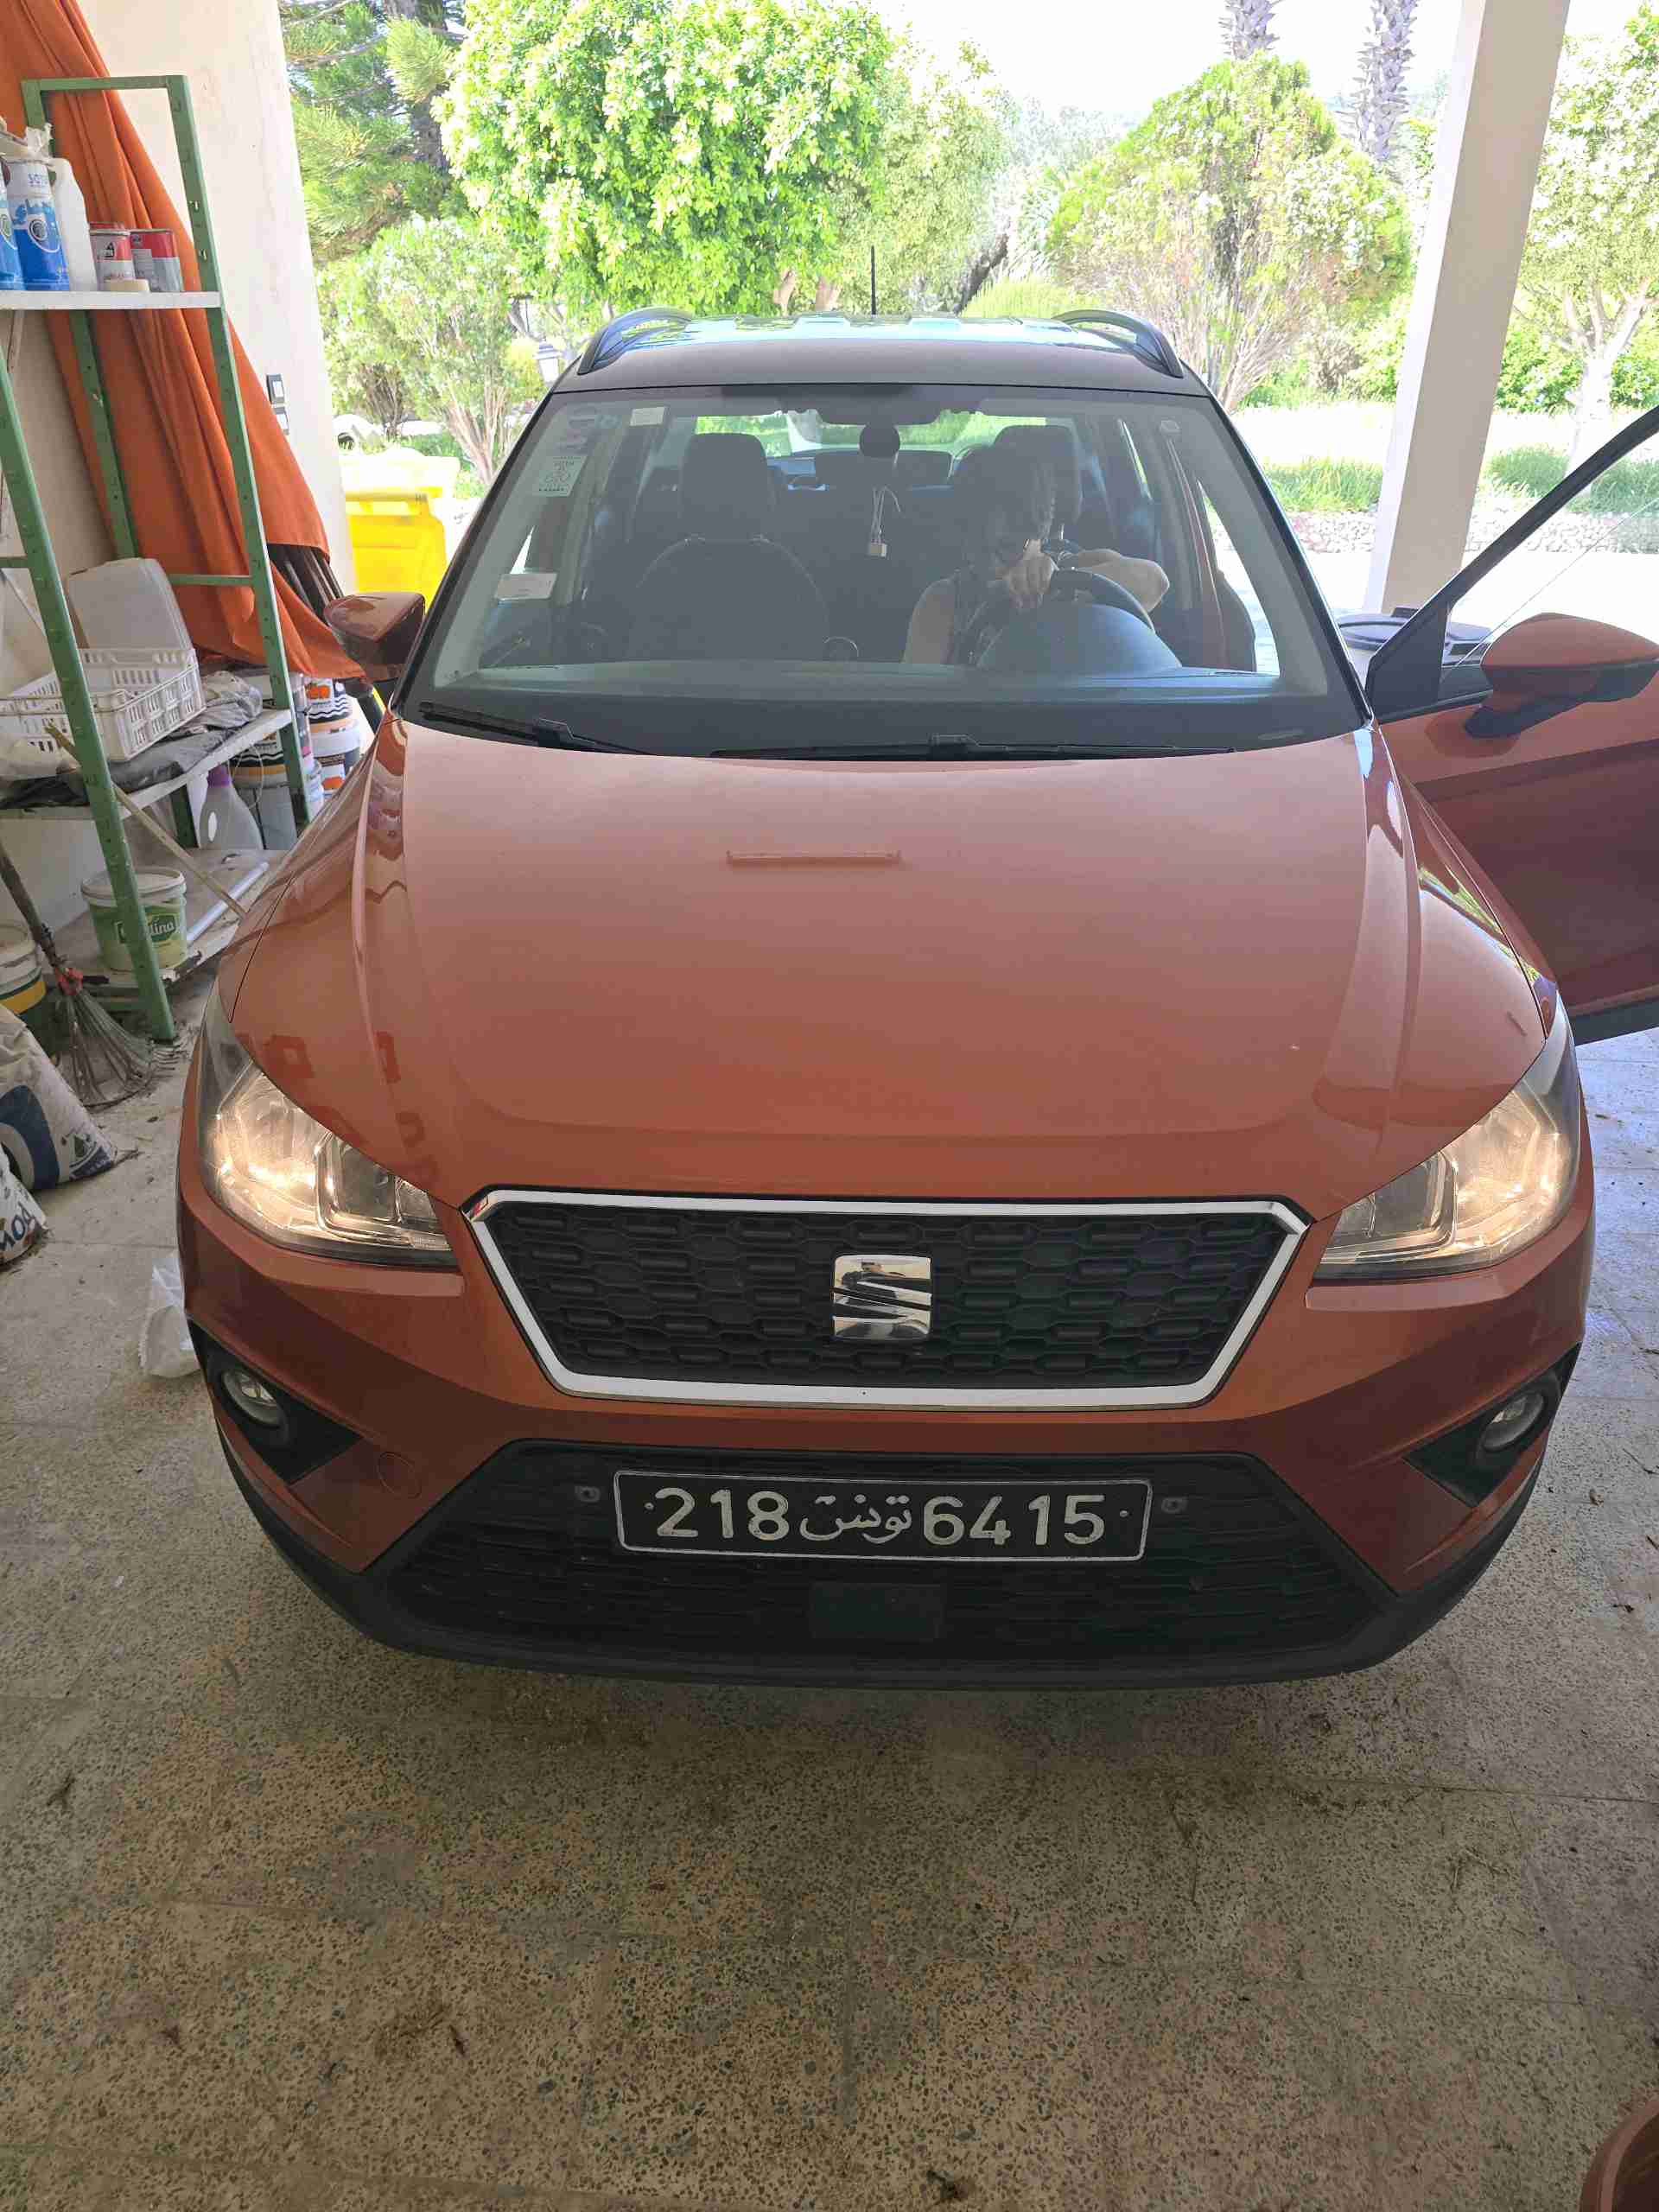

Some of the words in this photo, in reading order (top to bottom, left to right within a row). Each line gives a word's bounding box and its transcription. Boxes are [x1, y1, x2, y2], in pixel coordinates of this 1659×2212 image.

[654, 1487, 791, 1541] 218
[799, 1494, 912, 1544] تونس
[923, 1495, 1106, 1546] 6415
